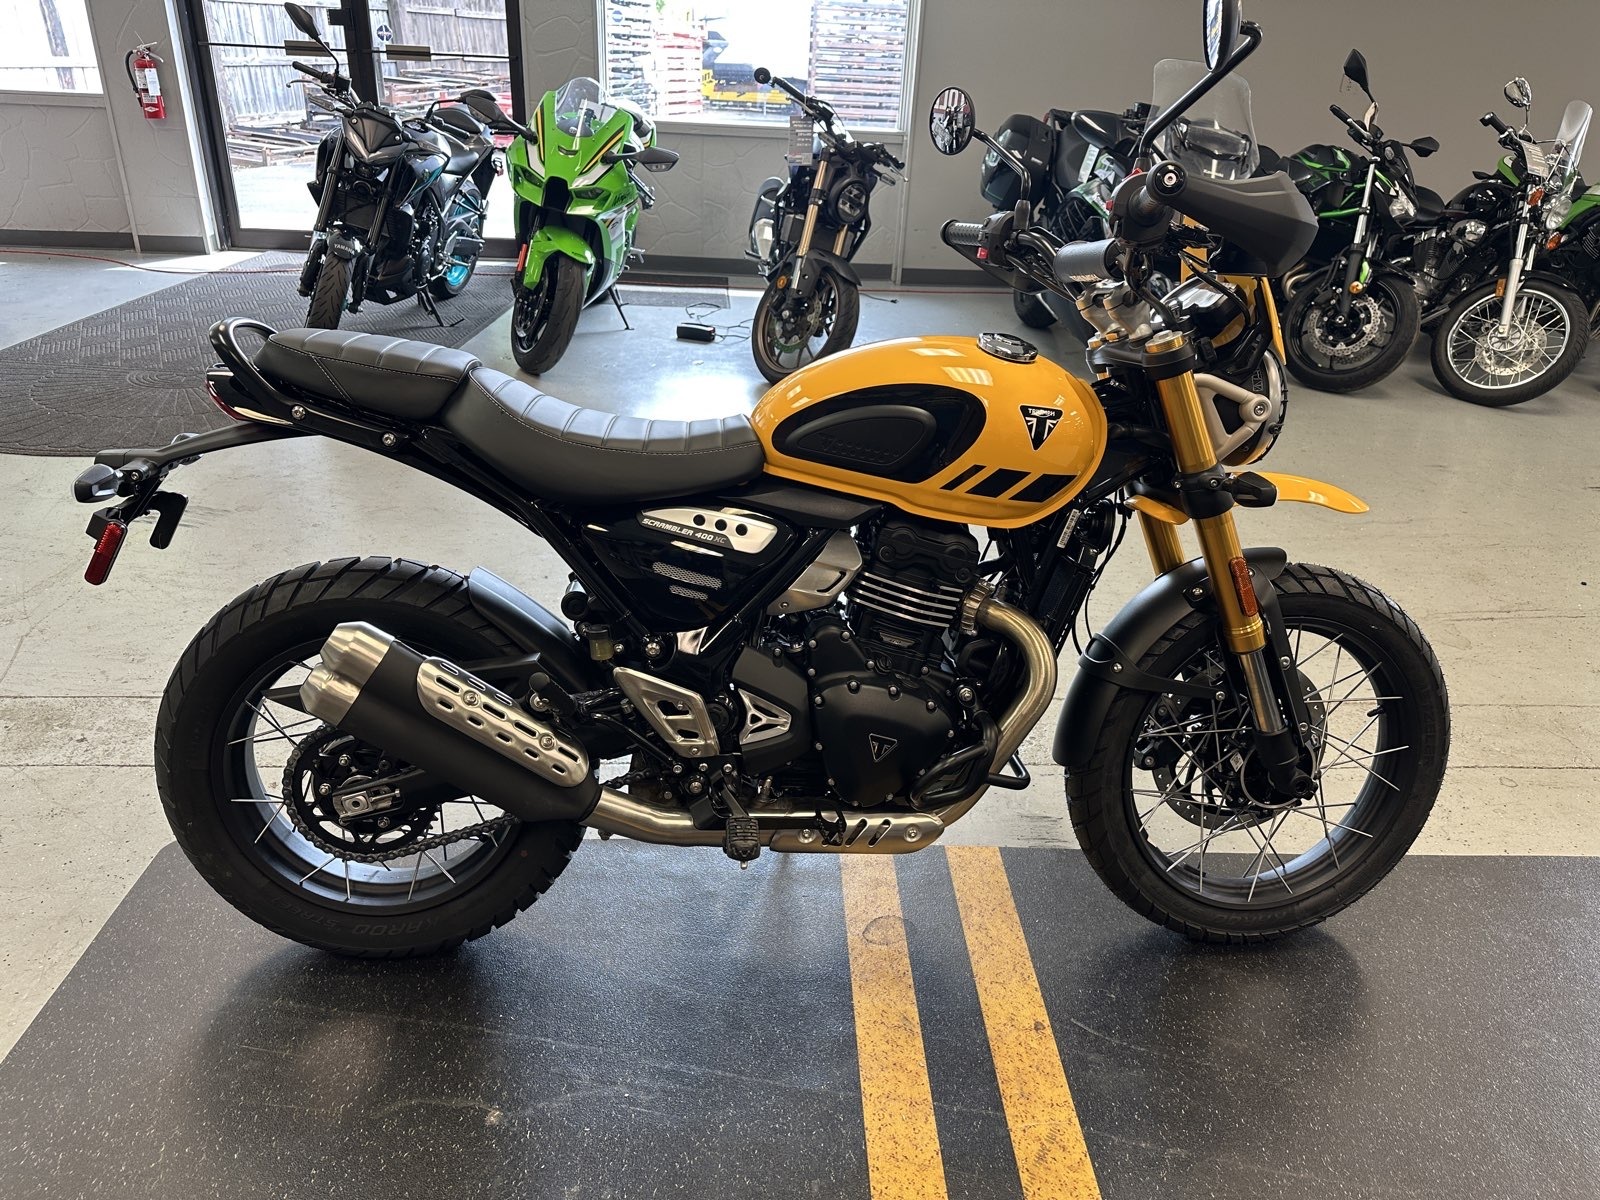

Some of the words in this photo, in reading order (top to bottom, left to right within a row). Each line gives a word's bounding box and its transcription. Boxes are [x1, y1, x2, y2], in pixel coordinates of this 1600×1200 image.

[333, 243, 355, 255] YAMAHA
[641, 517, 694, 537] SCRAMBLER
[694, 531, 715, 541] 400
[714, 535, 727, 544] XC
